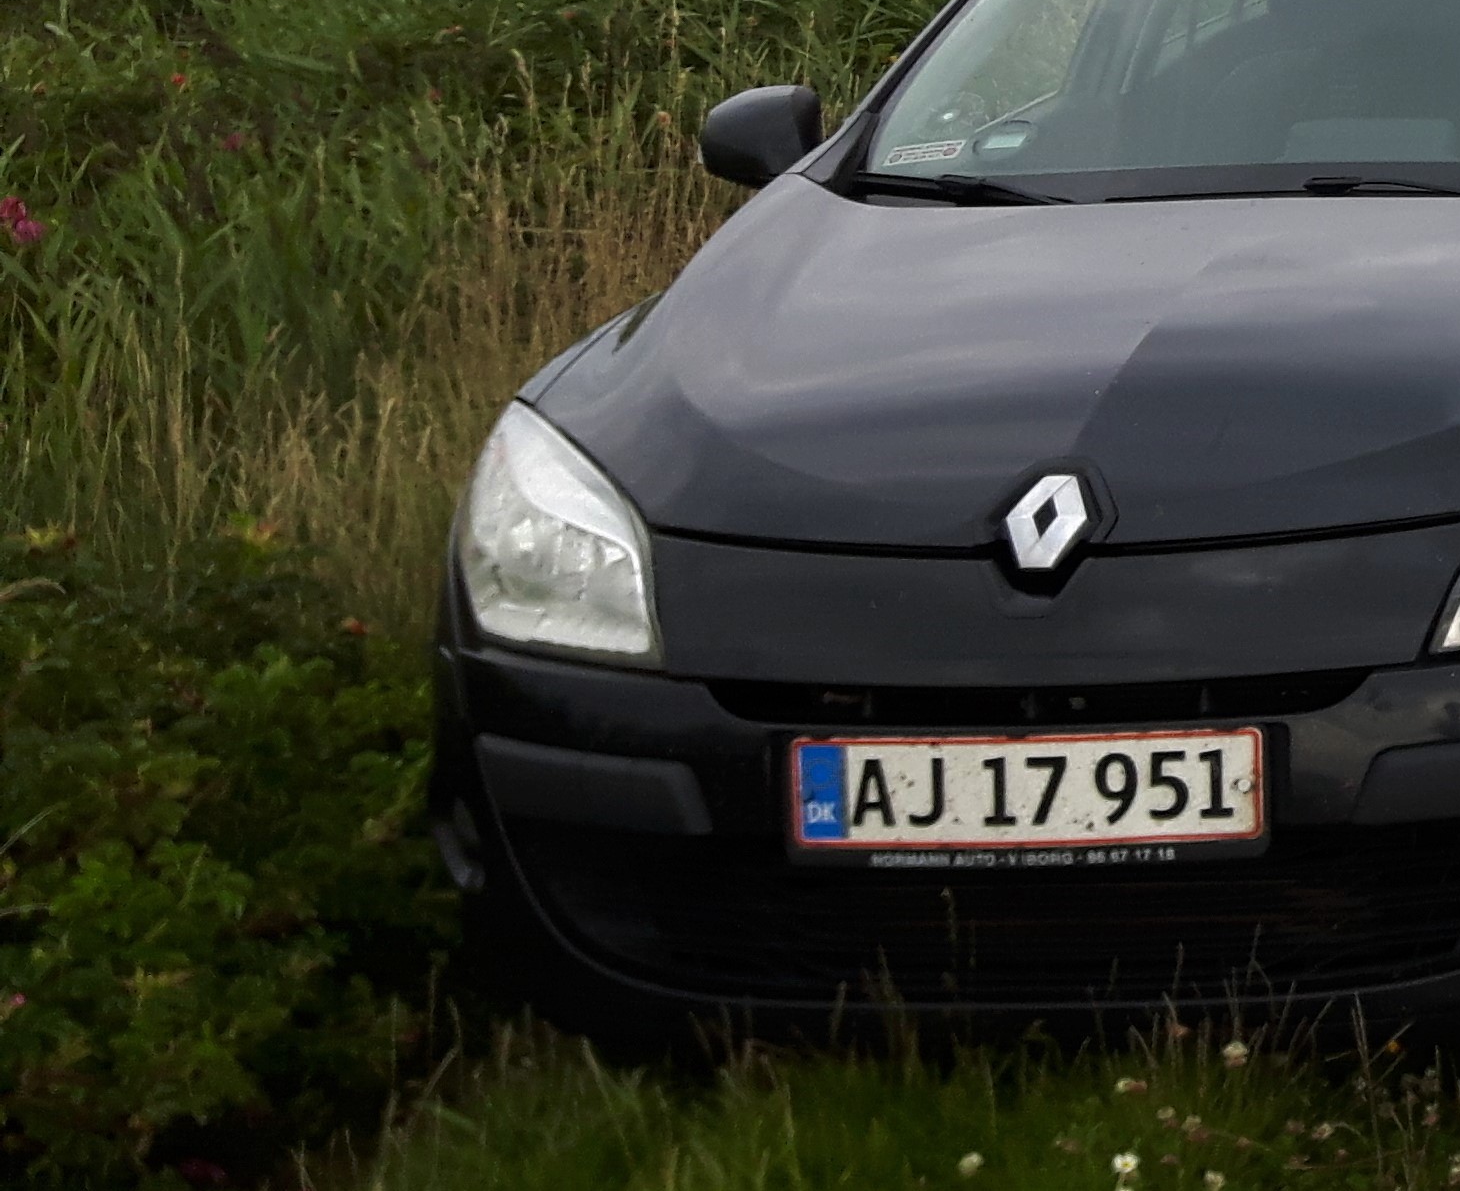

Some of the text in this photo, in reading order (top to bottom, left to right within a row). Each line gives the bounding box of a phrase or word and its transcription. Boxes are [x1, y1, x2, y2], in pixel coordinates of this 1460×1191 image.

[851, 748, 1235, 828] AJ 17 951
[805, 802, 837, 823] DK
[952, 851, 997, 867] AUTO
